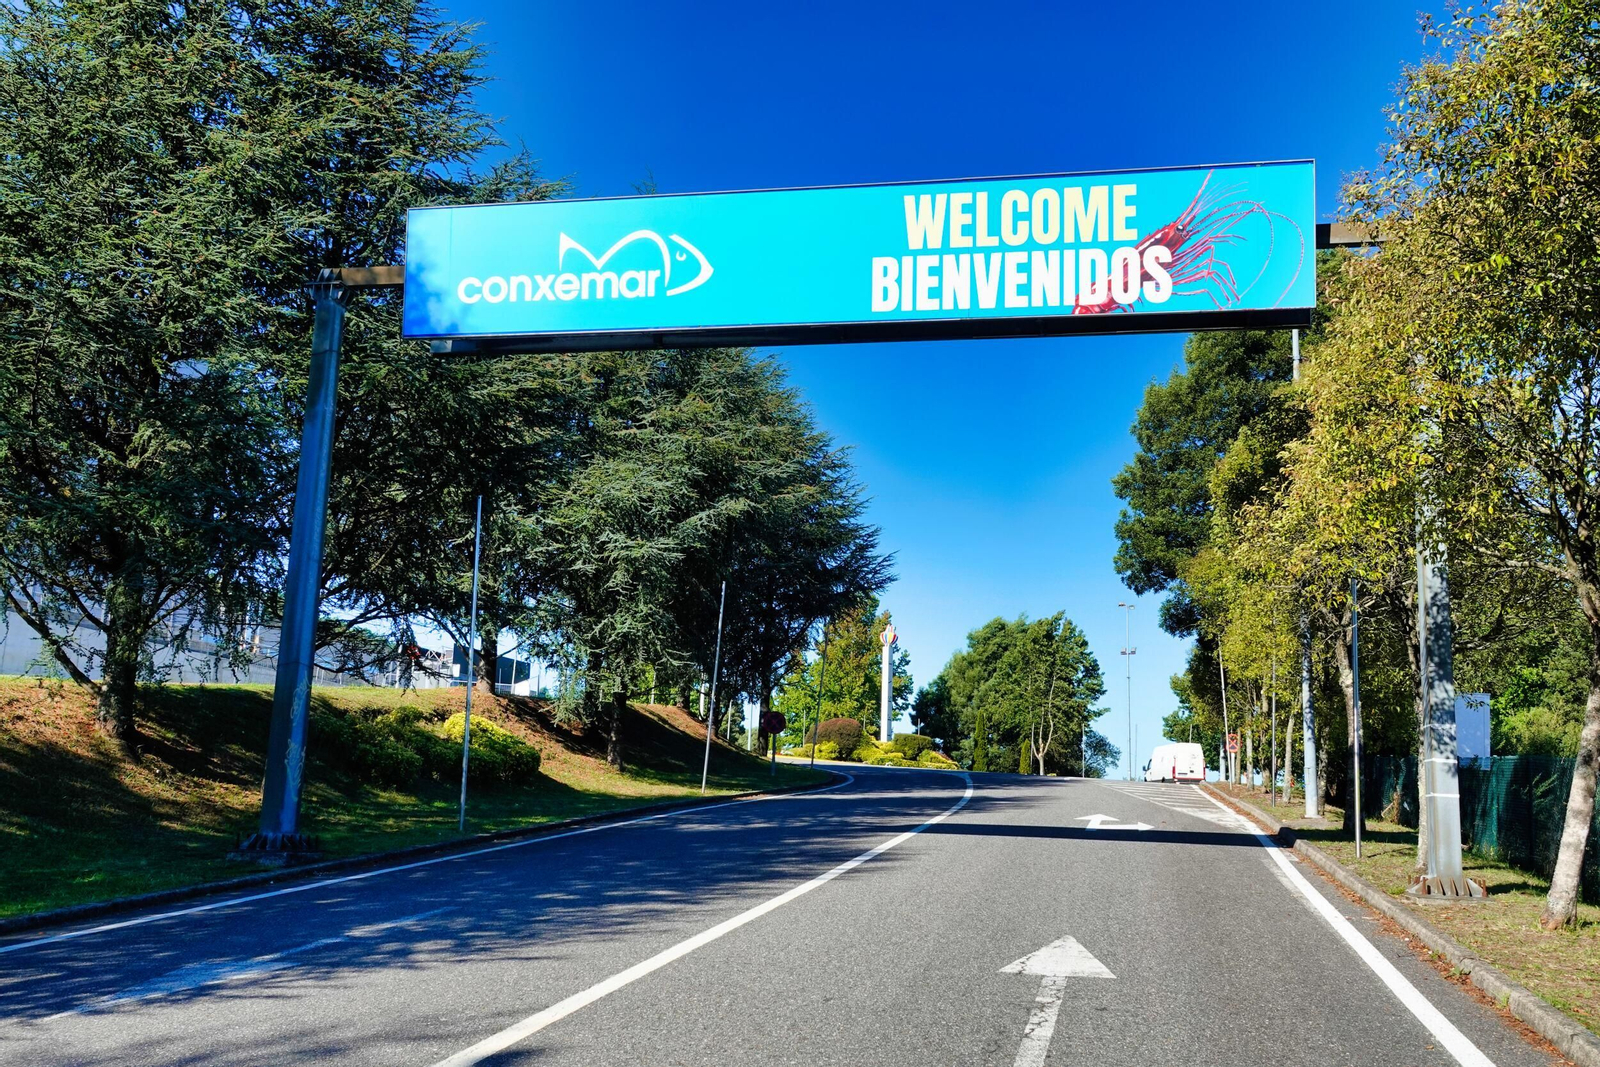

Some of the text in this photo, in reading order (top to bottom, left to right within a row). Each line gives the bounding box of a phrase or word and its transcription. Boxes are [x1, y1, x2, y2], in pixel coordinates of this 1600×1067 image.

[903, 184, 1138, 250] WELCOME
[457, 269, 661, 304] conxemar
[871, 245, 1173, 312] BIENVENIDOS
